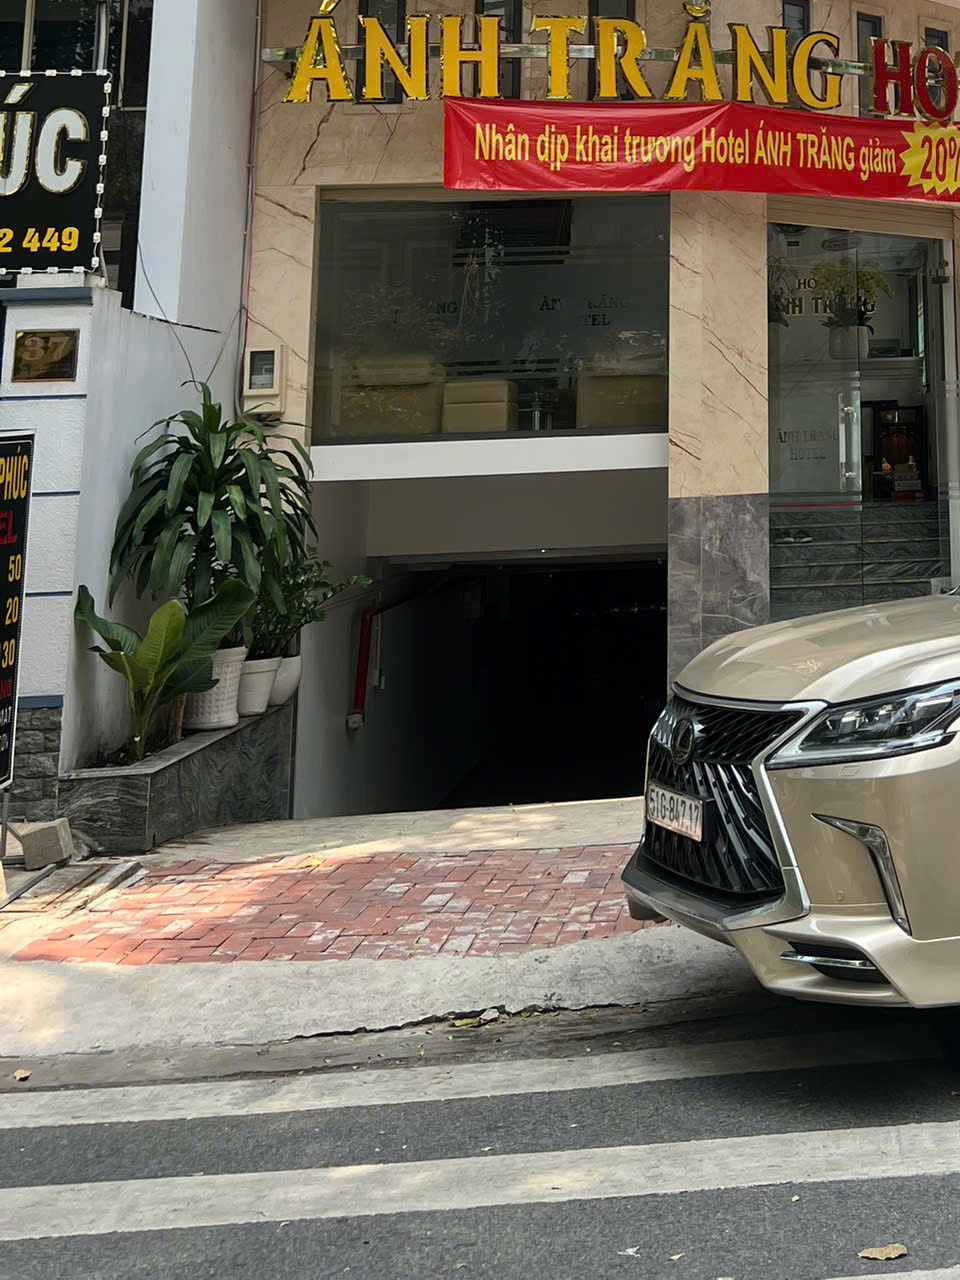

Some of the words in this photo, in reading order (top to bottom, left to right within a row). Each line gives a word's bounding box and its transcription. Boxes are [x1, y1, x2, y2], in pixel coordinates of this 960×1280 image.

[529, 1, 842, 109] TRĂNG
[474, 123, 529, 161] Nhân
[536, 124, 569, 171] dịp
[575, 125, 618, 162] khai
[624, 127, 695, 172] trương
[701, 126, 749, 164] Hotel
[754, 120, 791, 168] ÁNH
[796, 126, 856, 170] TRĂNG
[859, 136, 897, 180] giảm
[22, 227, 79, 252] 449
[23, 336, 69, 360] 37
